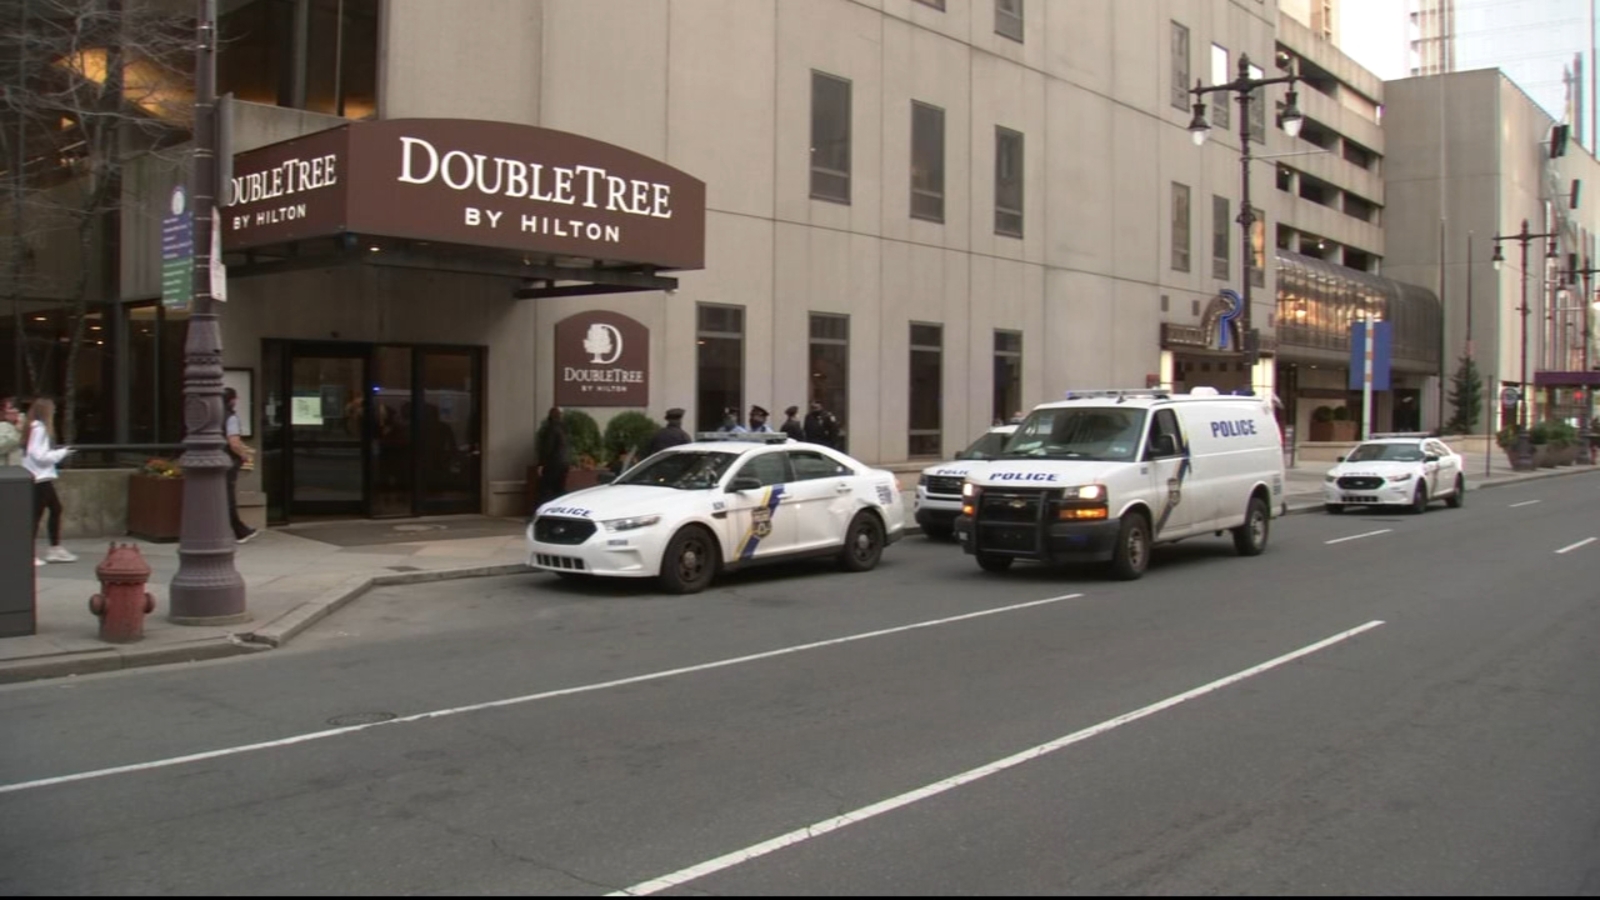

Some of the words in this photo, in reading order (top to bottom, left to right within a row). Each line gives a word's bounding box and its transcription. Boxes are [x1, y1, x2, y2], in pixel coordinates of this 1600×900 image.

[226, 154, 337, 207] OUBLETREE
[397, 136, 672, 219] DOUBLETREE
[233, 214, 250, 230] BY
[256, 204, 306, 226] HILTON
[464, 207, 503, 228] BY
[520, 214, 620, 243] HILTON
[564, 367, 644, 383] DOUBLETREE
[1211, 419, 1257, 438] POLICE
[988, 472, 1061, 482] POLICE
[543, 507, 592, 517] POLICE
